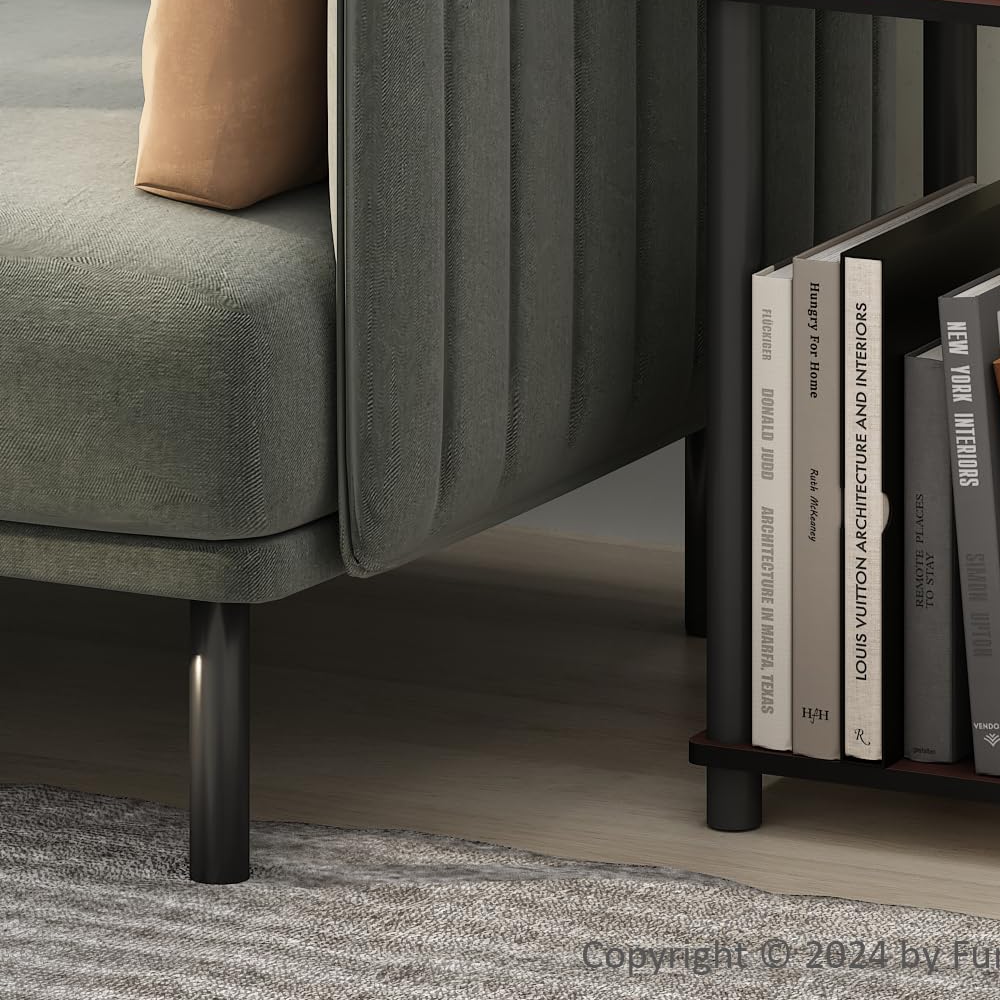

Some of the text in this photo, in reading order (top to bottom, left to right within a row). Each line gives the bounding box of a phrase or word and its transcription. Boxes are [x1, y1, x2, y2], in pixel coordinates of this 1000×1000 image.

[761, 308, 772, 361] FLÜCKIGER
[808, 282, 820, 399] Hungry For Home
[761, 388, 774, 480] DONALD JUDD
[947, 321, 980, 487] NEW YORK INTERIORS
[810, 468, 819, 492] Ruth
[856, 302, 867, 681] LOUIS VUITTON ARCHITECTURE AND INTERIORS
[916, 493, 924, 608] REMOTE PLACES
[926, 552, 934, 609] TO STAY
[761, 506, 775, 714] ARCHITECTURE IN MARFA, TEXAS
[855, 728, 871, 746] R
